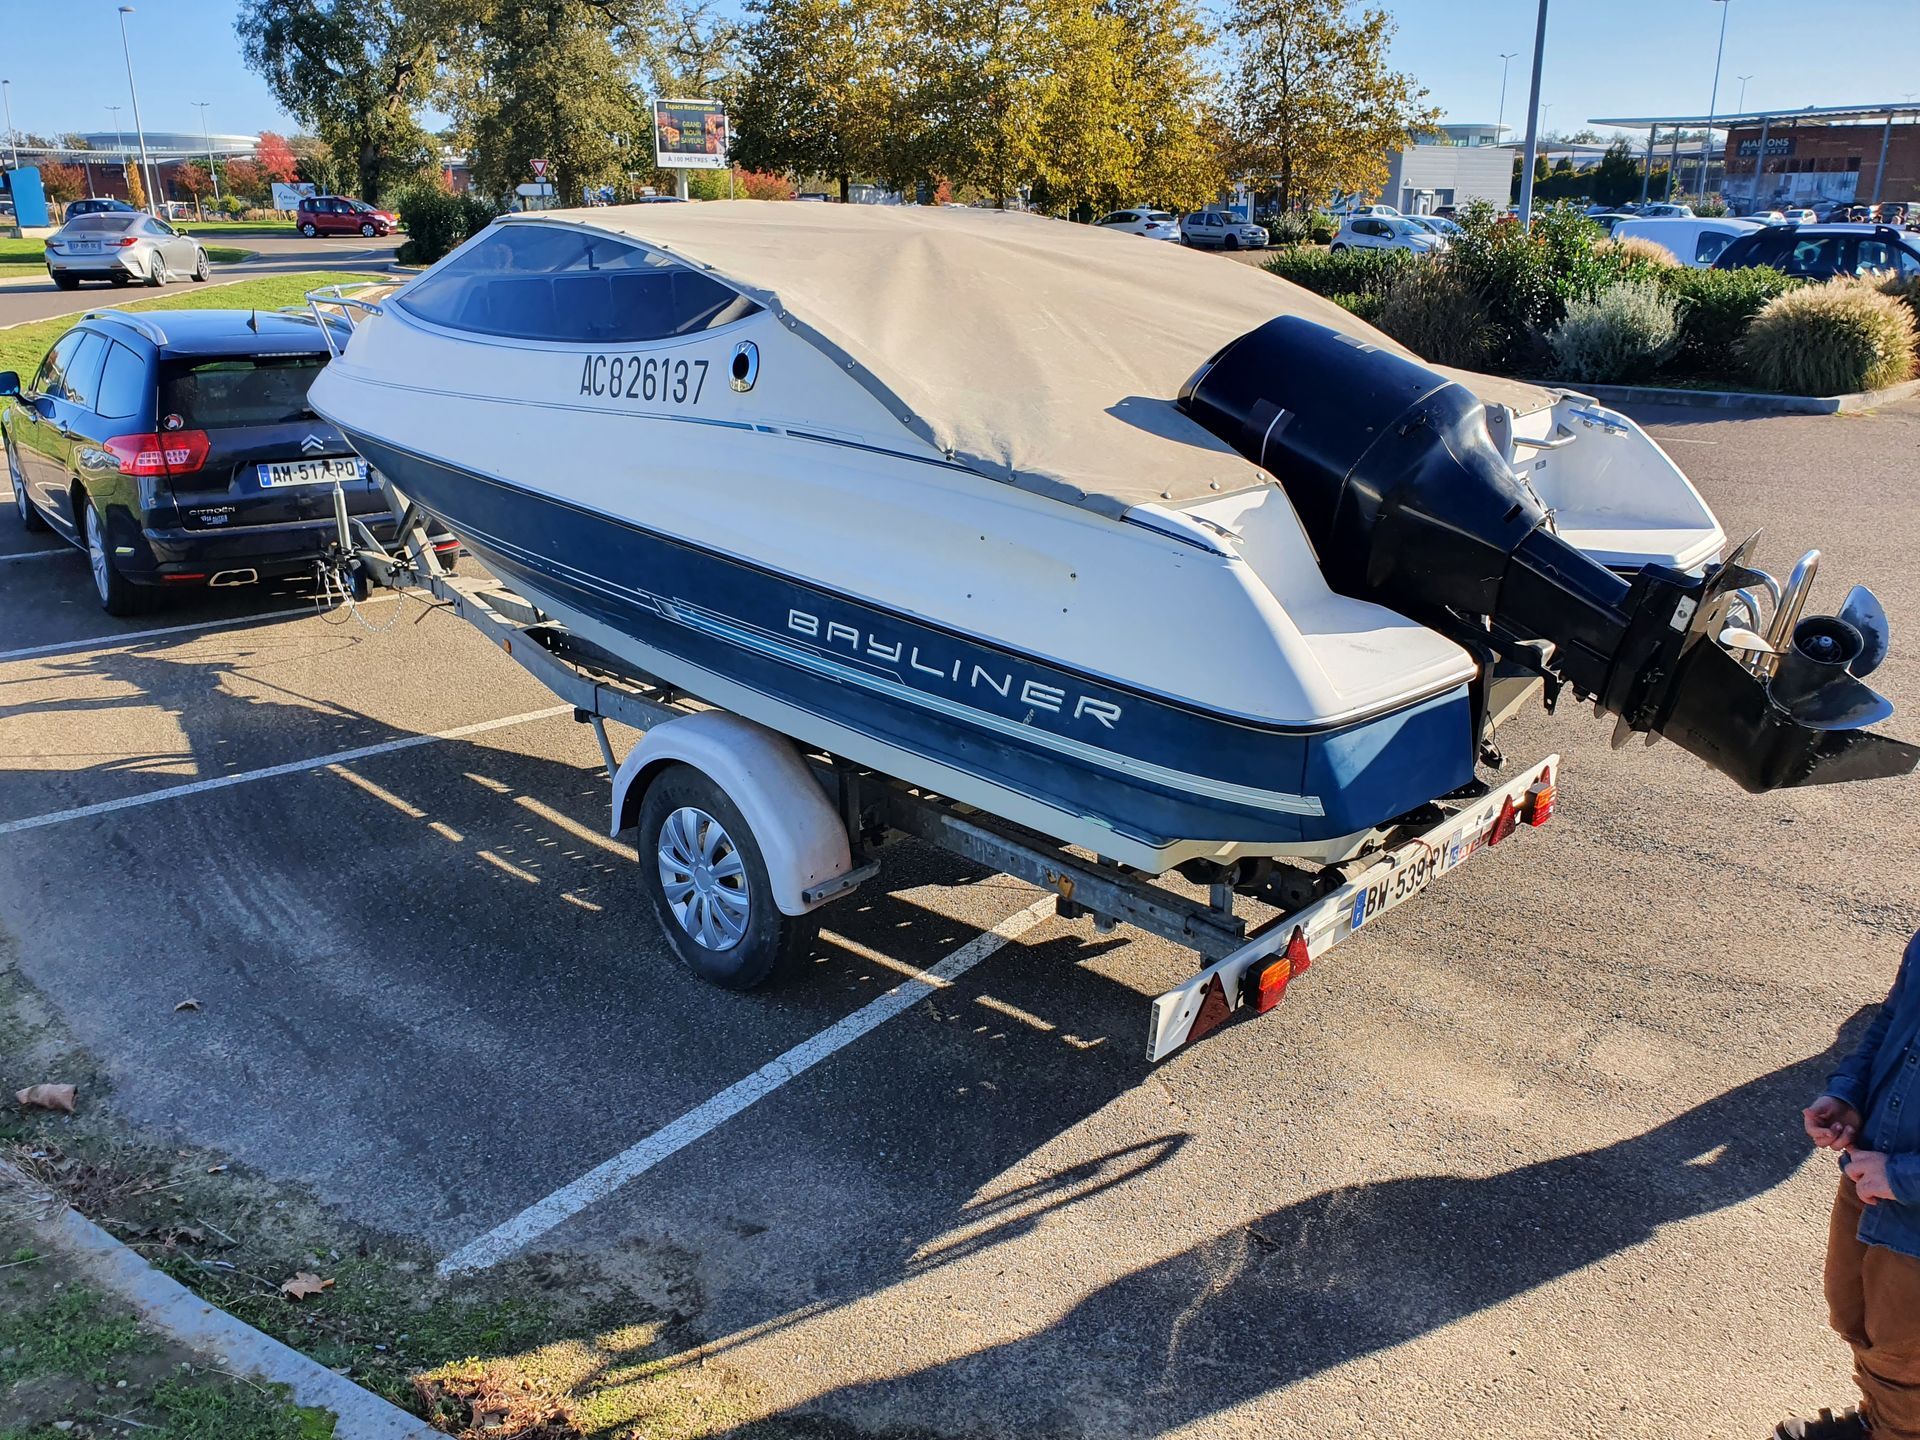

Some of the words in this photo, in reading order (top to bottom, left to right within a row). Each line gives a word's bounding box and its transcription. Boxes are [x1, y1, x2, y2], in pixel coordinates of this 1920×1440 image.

[1741, 138, 1789, 147] MAIONS
[580, 354, 709, 405] AC826137
[788, 608, 1122, 730] BAYLINER
